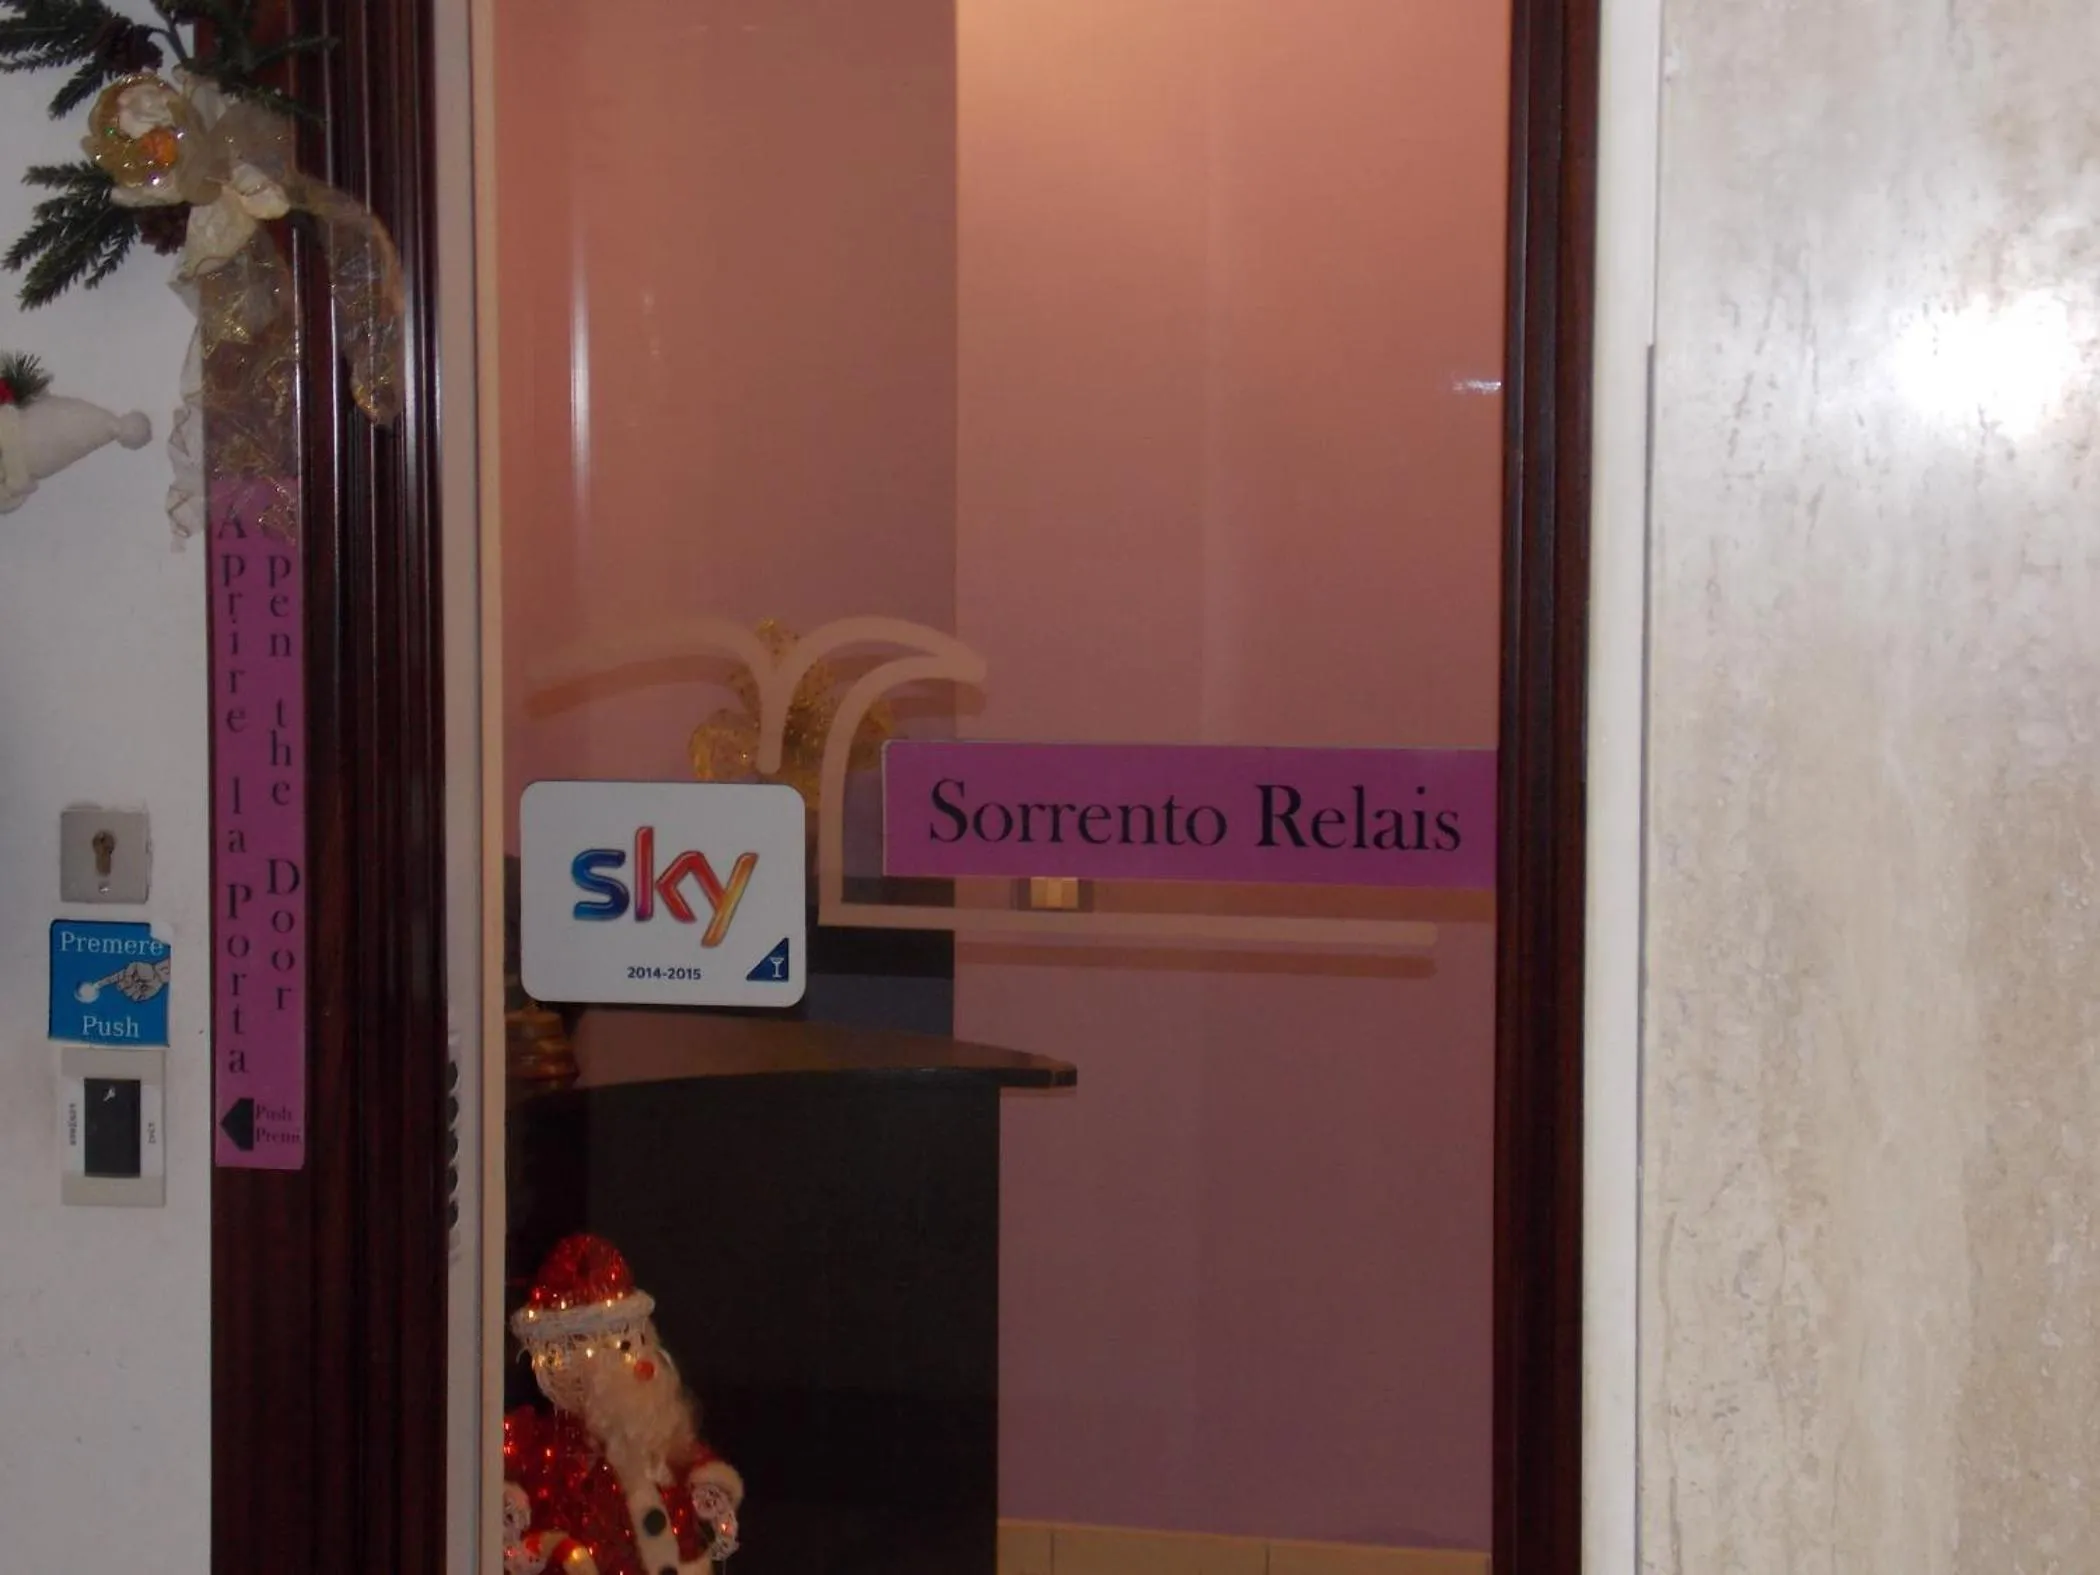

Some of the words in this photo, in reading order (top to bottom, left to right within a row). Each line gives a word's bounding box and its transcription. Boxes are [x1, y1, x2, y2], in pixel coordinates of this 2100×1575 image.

[269, 698, 292, 806] the
[228, 776, 247, 853] la
[929, 778, 1228, 848] Sorrento
[1255, 784, 1462, 853] Relais
[571, 825, 759, 949] sky
[60, 930, 165, 957] Premere
[267, 858, 300, 1011] Door
[627, 965, 702, 981] 2014-2015
[81, 1013, 140, 1039] Push
